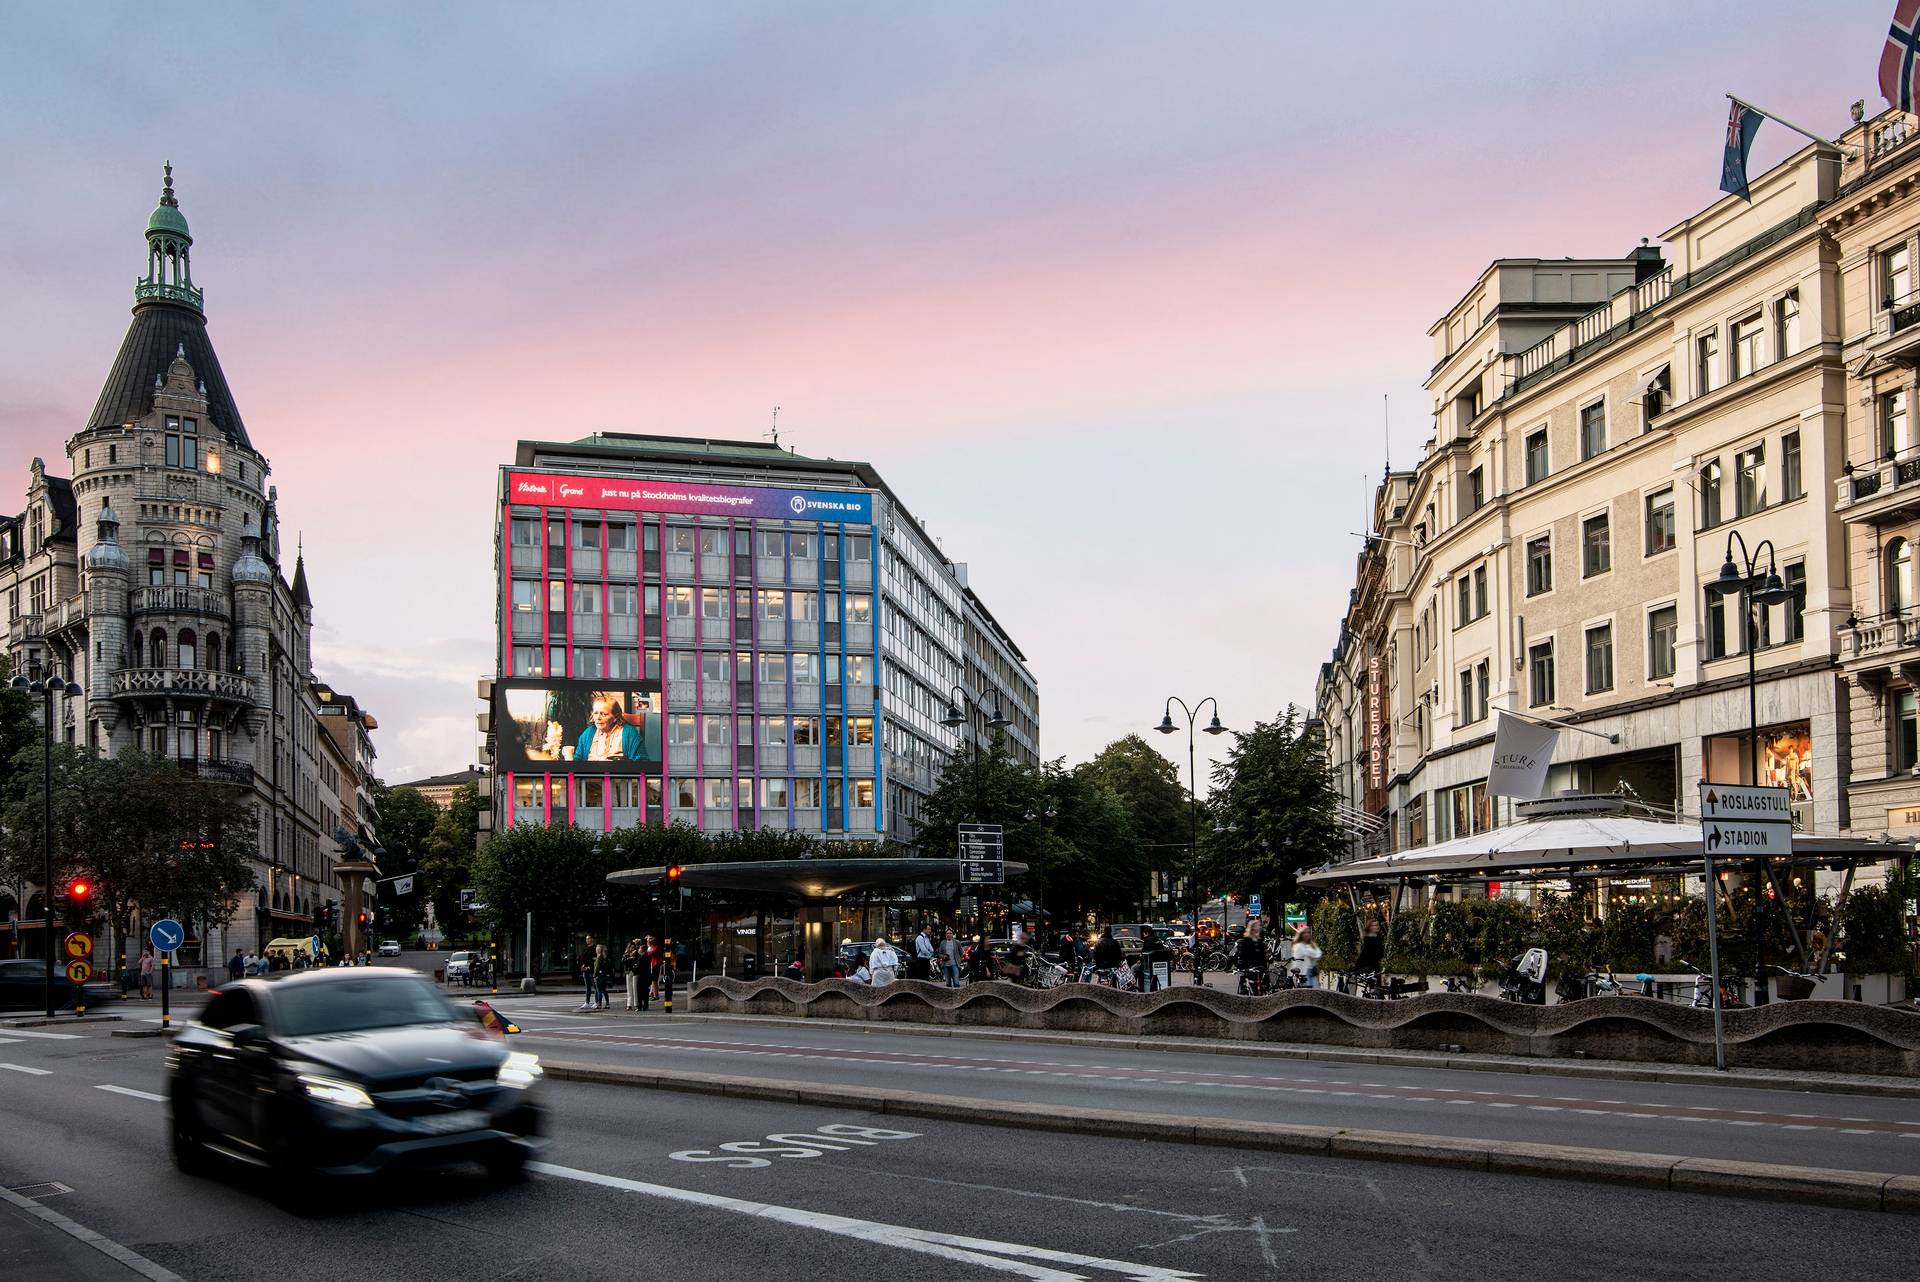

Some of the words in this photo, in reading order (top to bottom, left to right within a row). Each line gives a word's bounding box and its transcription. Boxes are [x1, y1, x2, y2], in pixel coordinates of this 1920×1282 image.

[560, 484, 584, 498] Grand
[601, 488, 617, 498] Just
[631, 490, 641, 499] på
[642, 490, 687, 501] Stockholms
[689, 494, 754, 505] kvalitetsbiografer
[807, 501, 845, 510] SVENSKA
[846, 503, 861, 511] BIO
[1370, 657, 1380, 788] STUREBADET
[1494, 753, 1536, 769] STURE
[1722, 795, 1788, 811] ROSLAGSTULL
[1724, 830, 1768, 846] STADION
[668, 1123, 924, 1168] BUSS
